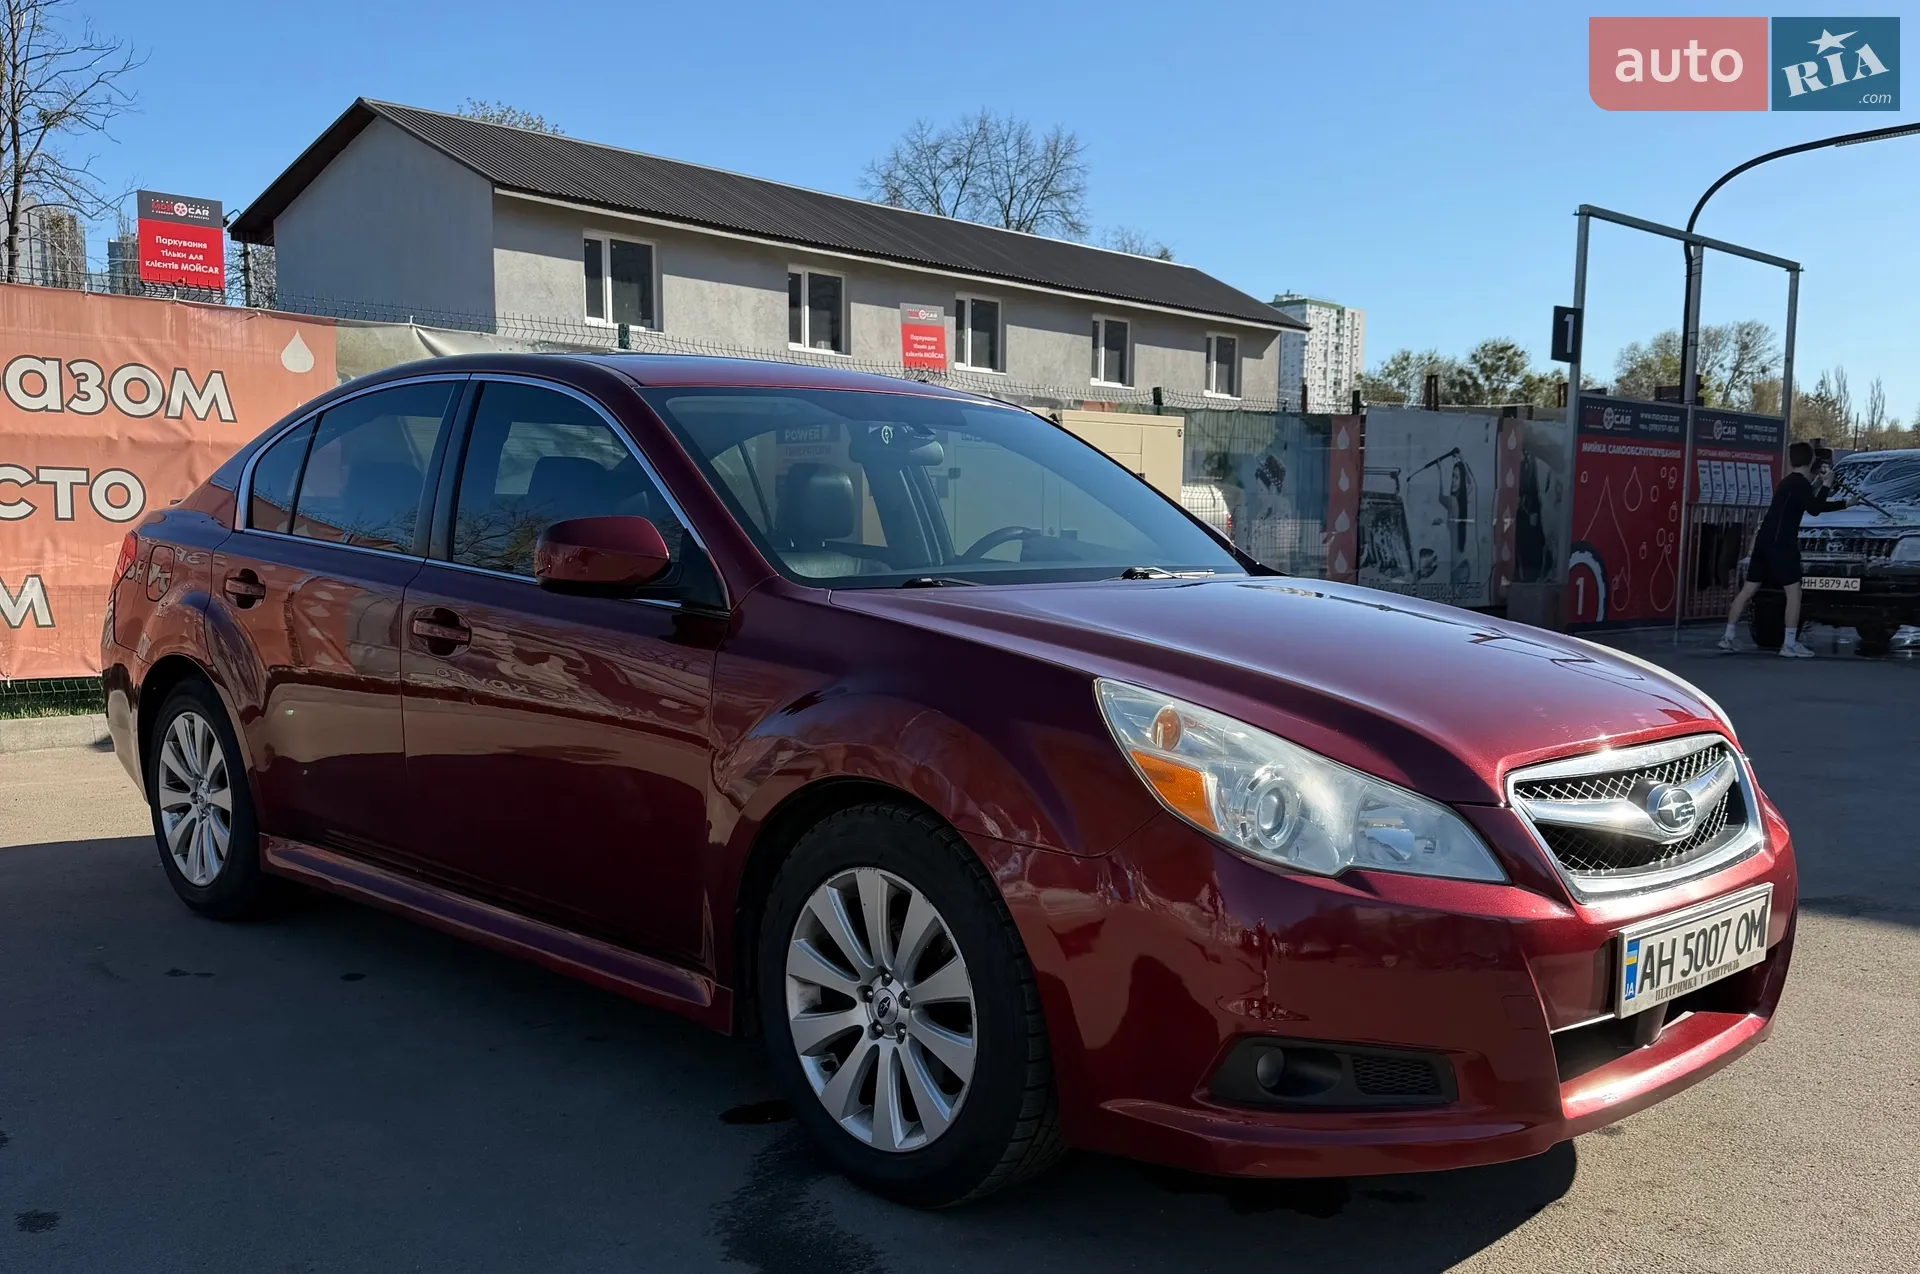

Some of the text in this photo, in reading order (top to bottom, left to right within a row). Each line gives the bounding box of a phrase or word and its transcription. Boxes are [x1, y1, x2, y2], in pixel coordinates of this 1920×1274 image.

[188, 207, 210, 216] CAR
[155, 235, 208, 249] Паркування
[160, 249, 204, 261] тільки для
[145, 259, 179, 270] клієнтів
[1563, 313, 1575, 354] 1
[0, 354, 238, 423] азом
[1614, 414, 1632, 425] CAR
[784, 428, 821, 441] POWER
[1722, 426, 1737, 436] CAR
[1582, 441, 1607, 453] МИЙКА
[1819, 578, 1841, 589] 5879
[1843, 580, 1858, 589] AC
[1575, 576, 1585, 616] 1
[1637, 904, 1766, 995] AH 5007 OM
